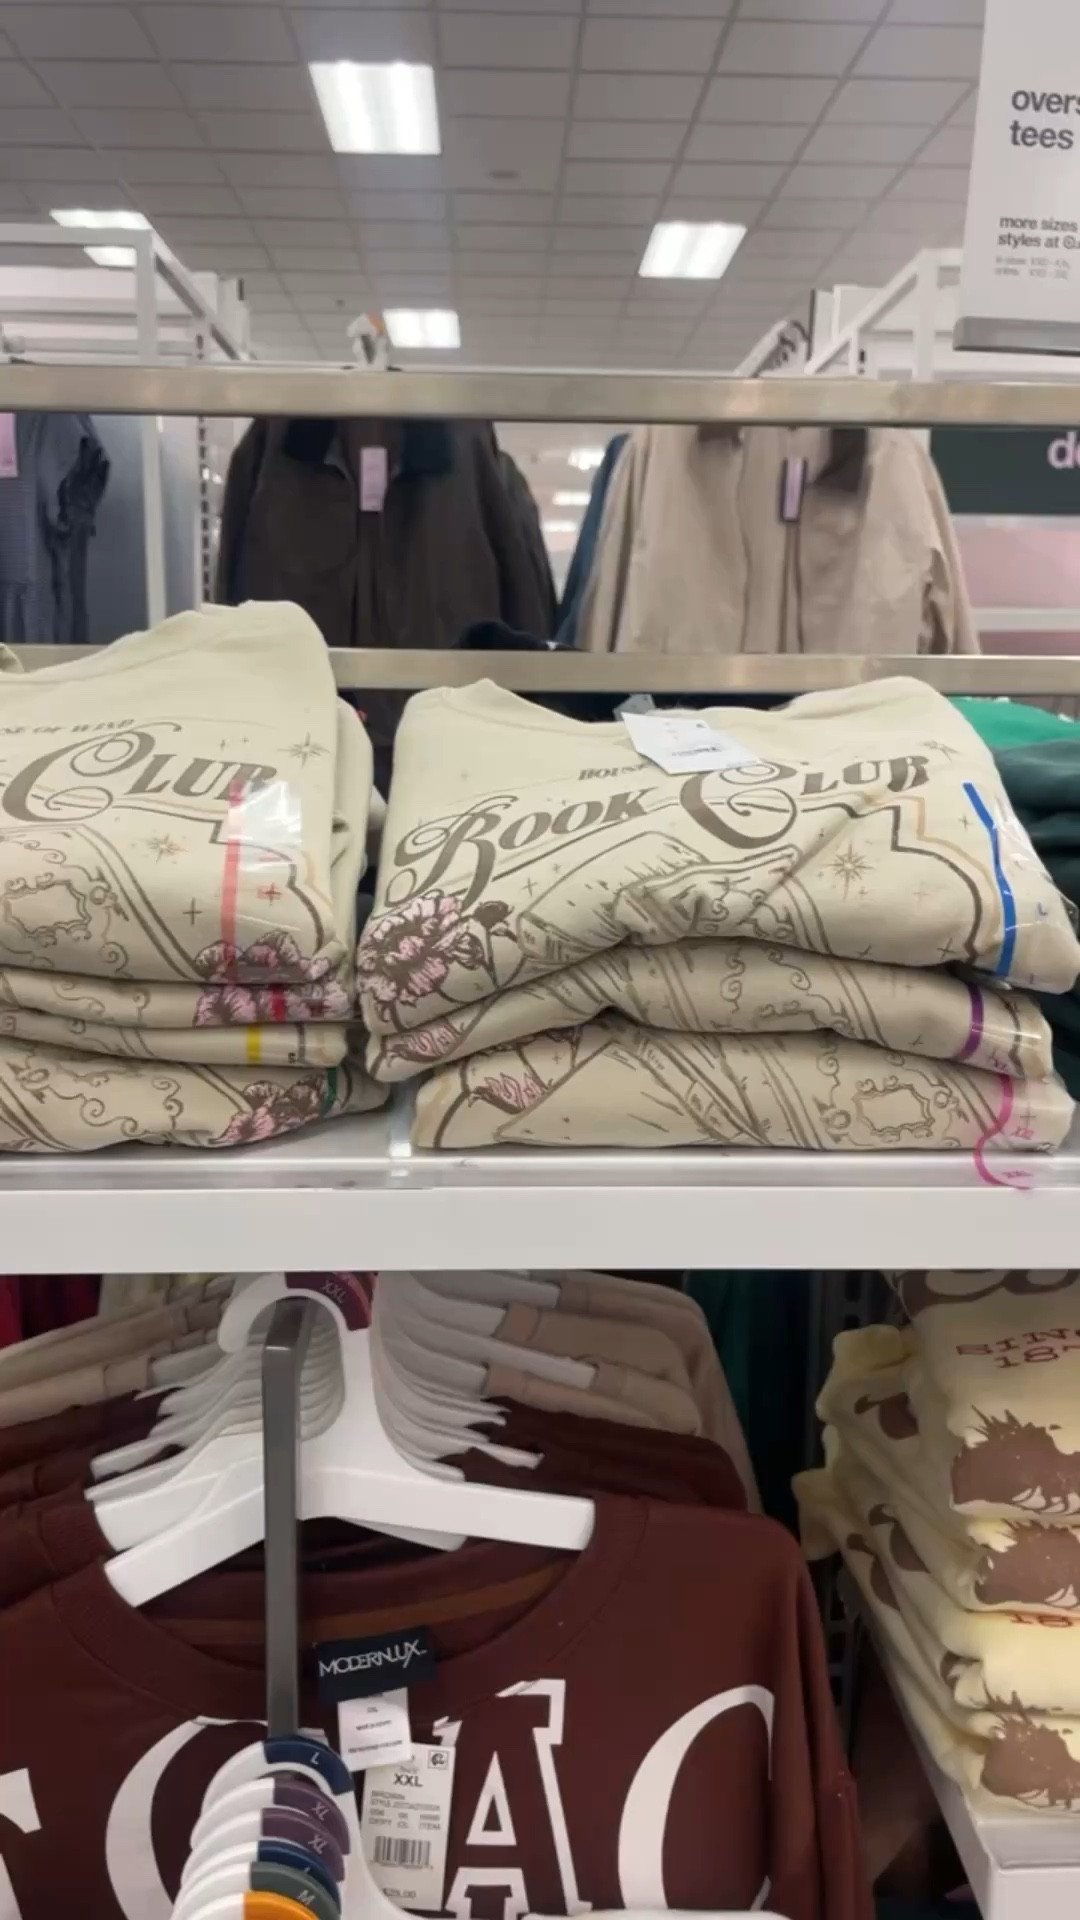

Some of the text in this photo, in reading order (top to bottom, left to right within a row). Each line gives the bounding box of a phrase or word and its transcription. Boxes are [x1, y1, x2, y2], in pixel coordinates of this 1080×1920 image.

[1010, 120, 1074, 150] tees
[999, 217, 1078, 232] more sizes
[998, 232, 1041, 249] styles
[1044, 236, 1059, 248] at
[680, 755, 930, 850] CLUB
[318, 1639, 422, 1678] MODERNLUX
[310, 1751, 320, 1765] L
[393, 1773, 424, 1788] XXL
[311, 1801, 330, 1821] XL
[307, 1834, 328, 1855] XL
[297, 1889, 316, 1906] M
